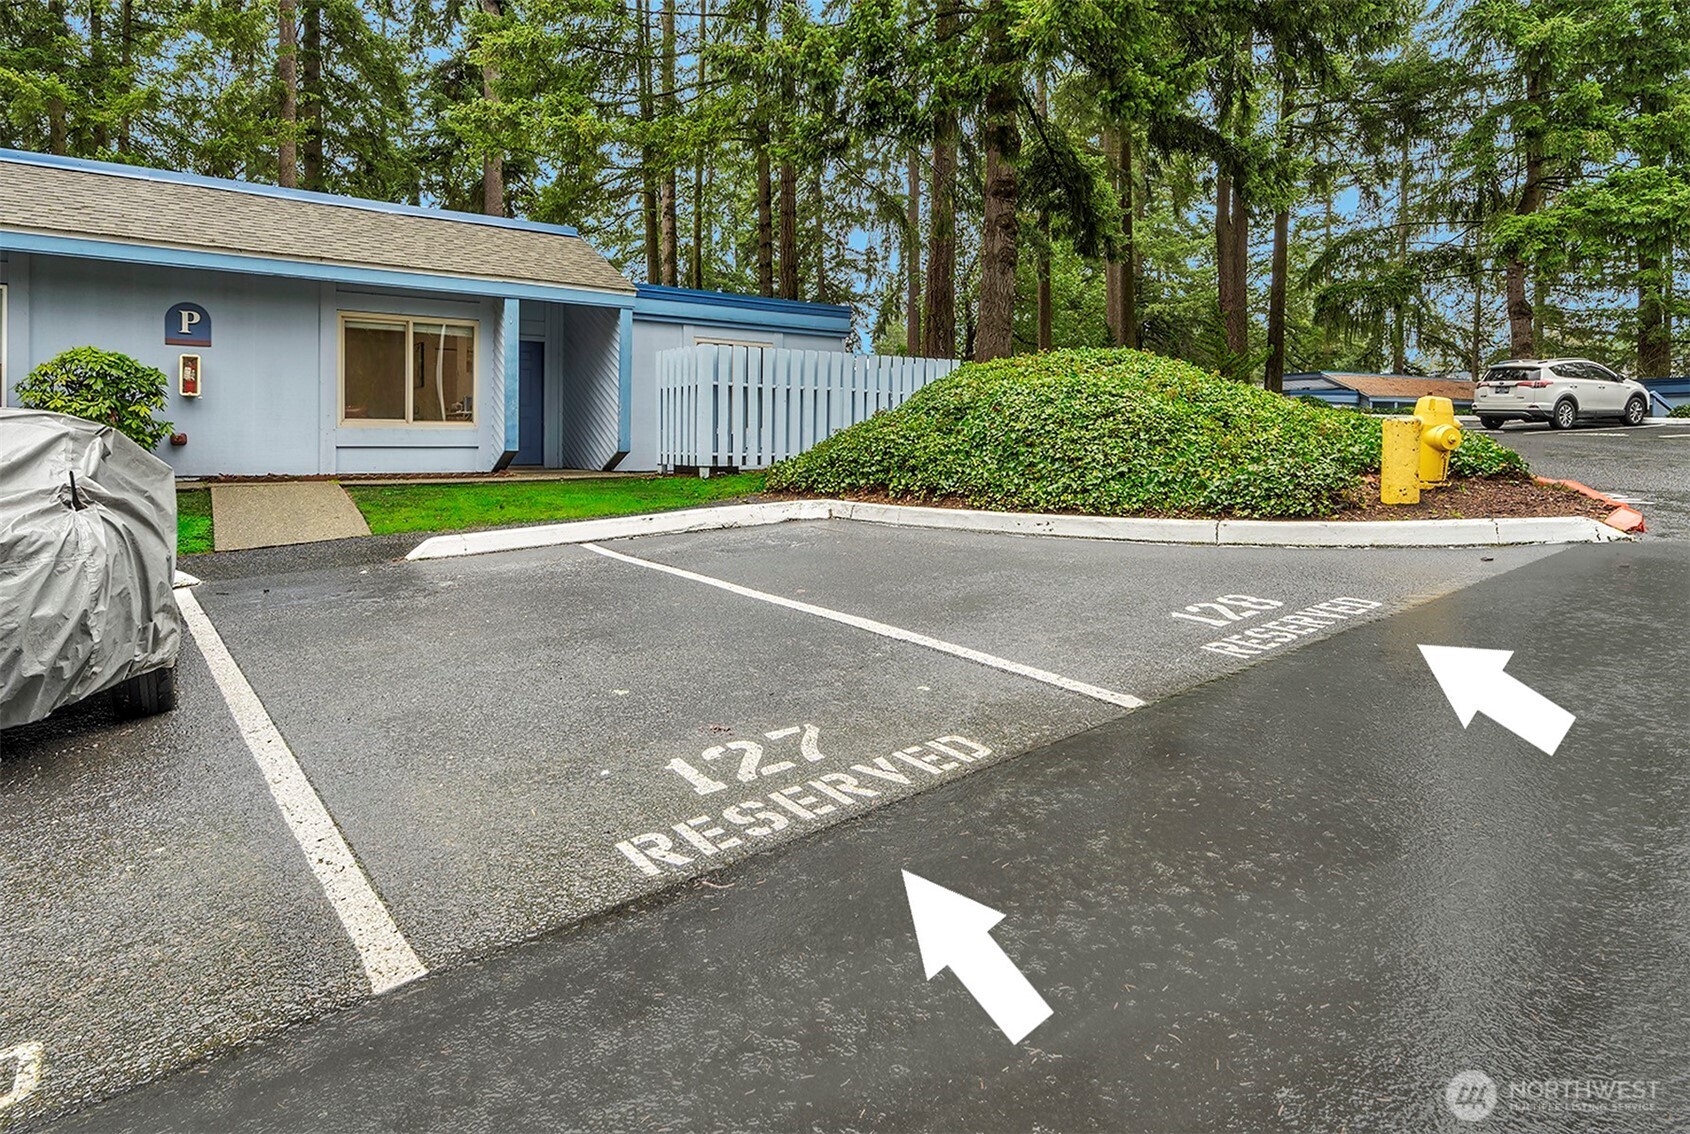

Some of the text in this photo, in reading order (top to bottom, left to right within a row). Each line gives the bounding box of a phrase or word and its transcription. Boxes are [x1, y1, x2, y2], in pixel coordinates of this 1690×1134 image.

[178, 310, 201, 334] P
[1171, 594, 1283, 628] 128
[1200, 597, 1383, 658] RESERVED
[665, 723, 826, 796] 127
[615, 735, 994, 877] RESERVED
